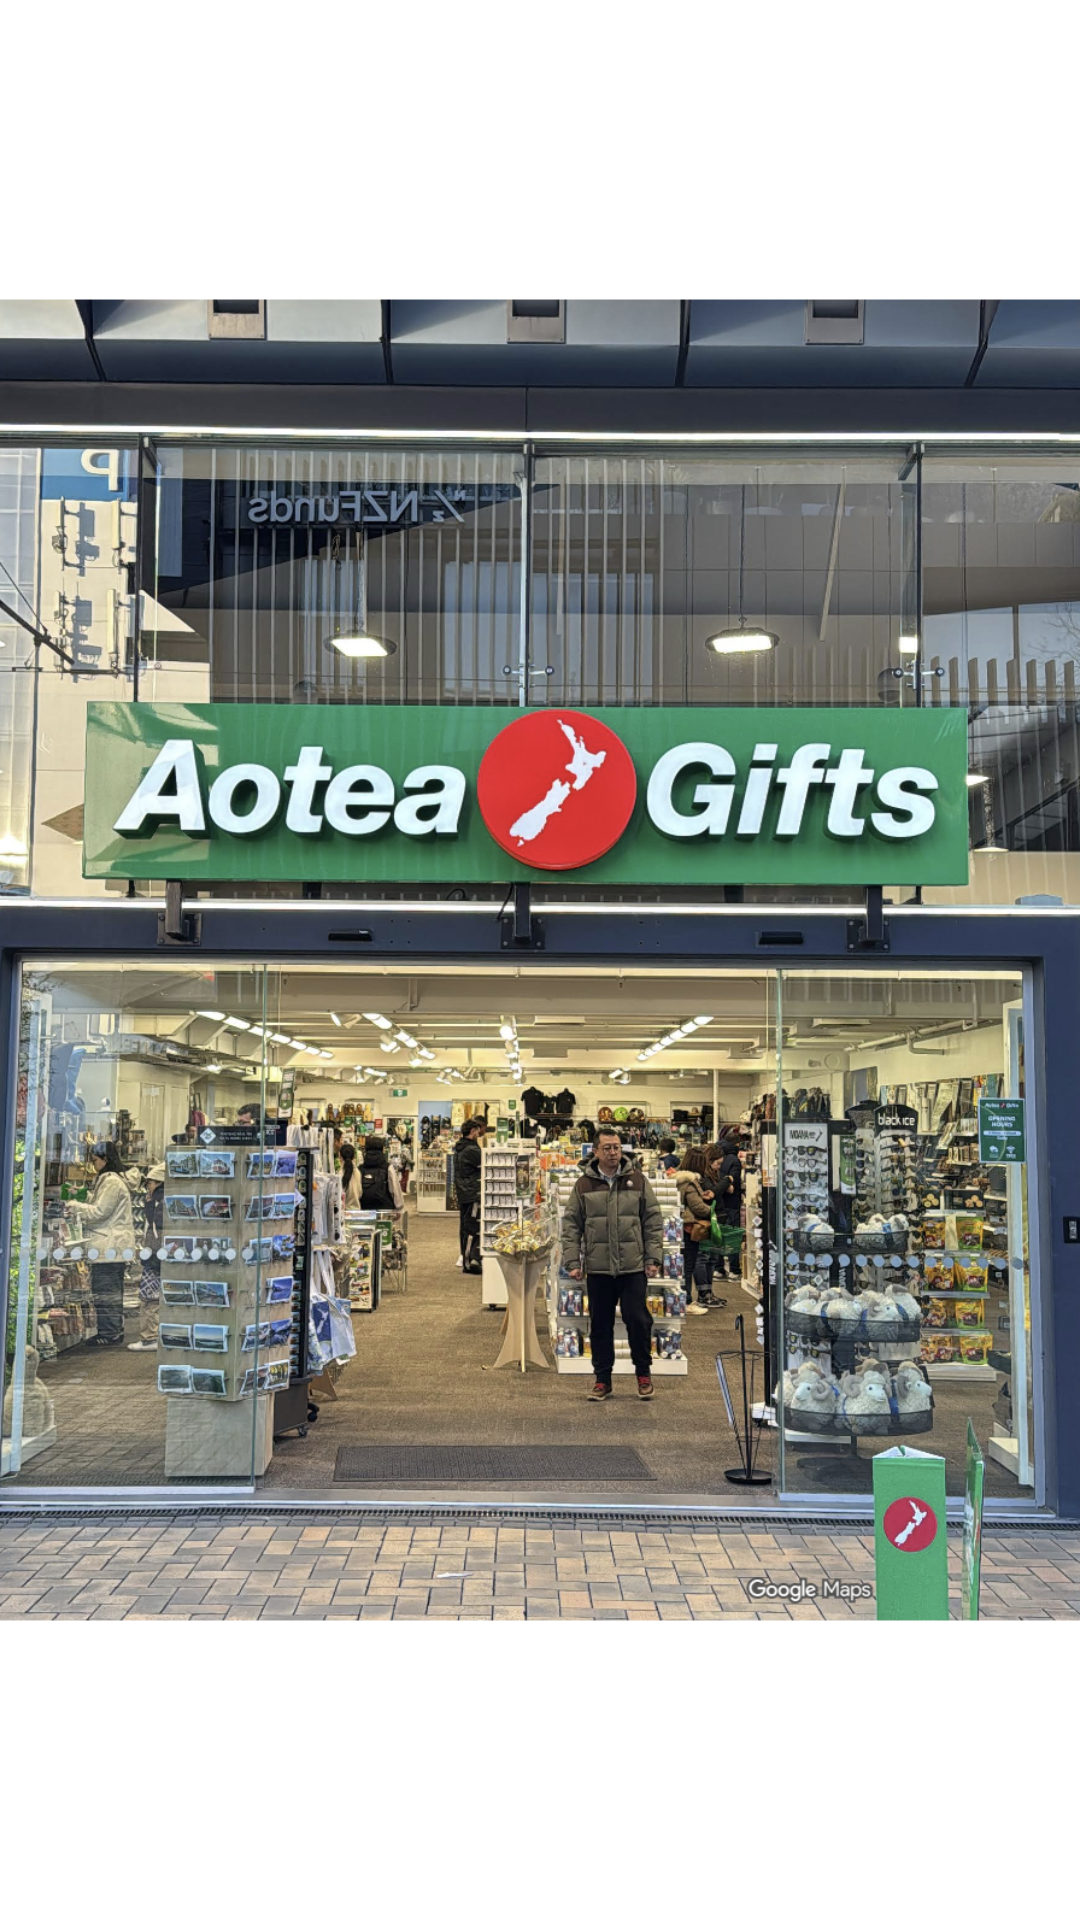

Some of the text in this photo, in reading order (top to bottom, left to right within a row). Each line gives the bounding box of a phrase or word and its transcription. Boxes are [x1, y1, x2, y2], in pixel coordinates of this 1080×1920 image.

[112, 739, 939, 838] Aotea Gifts
[789, 1129, 810, 1140] MOANA
